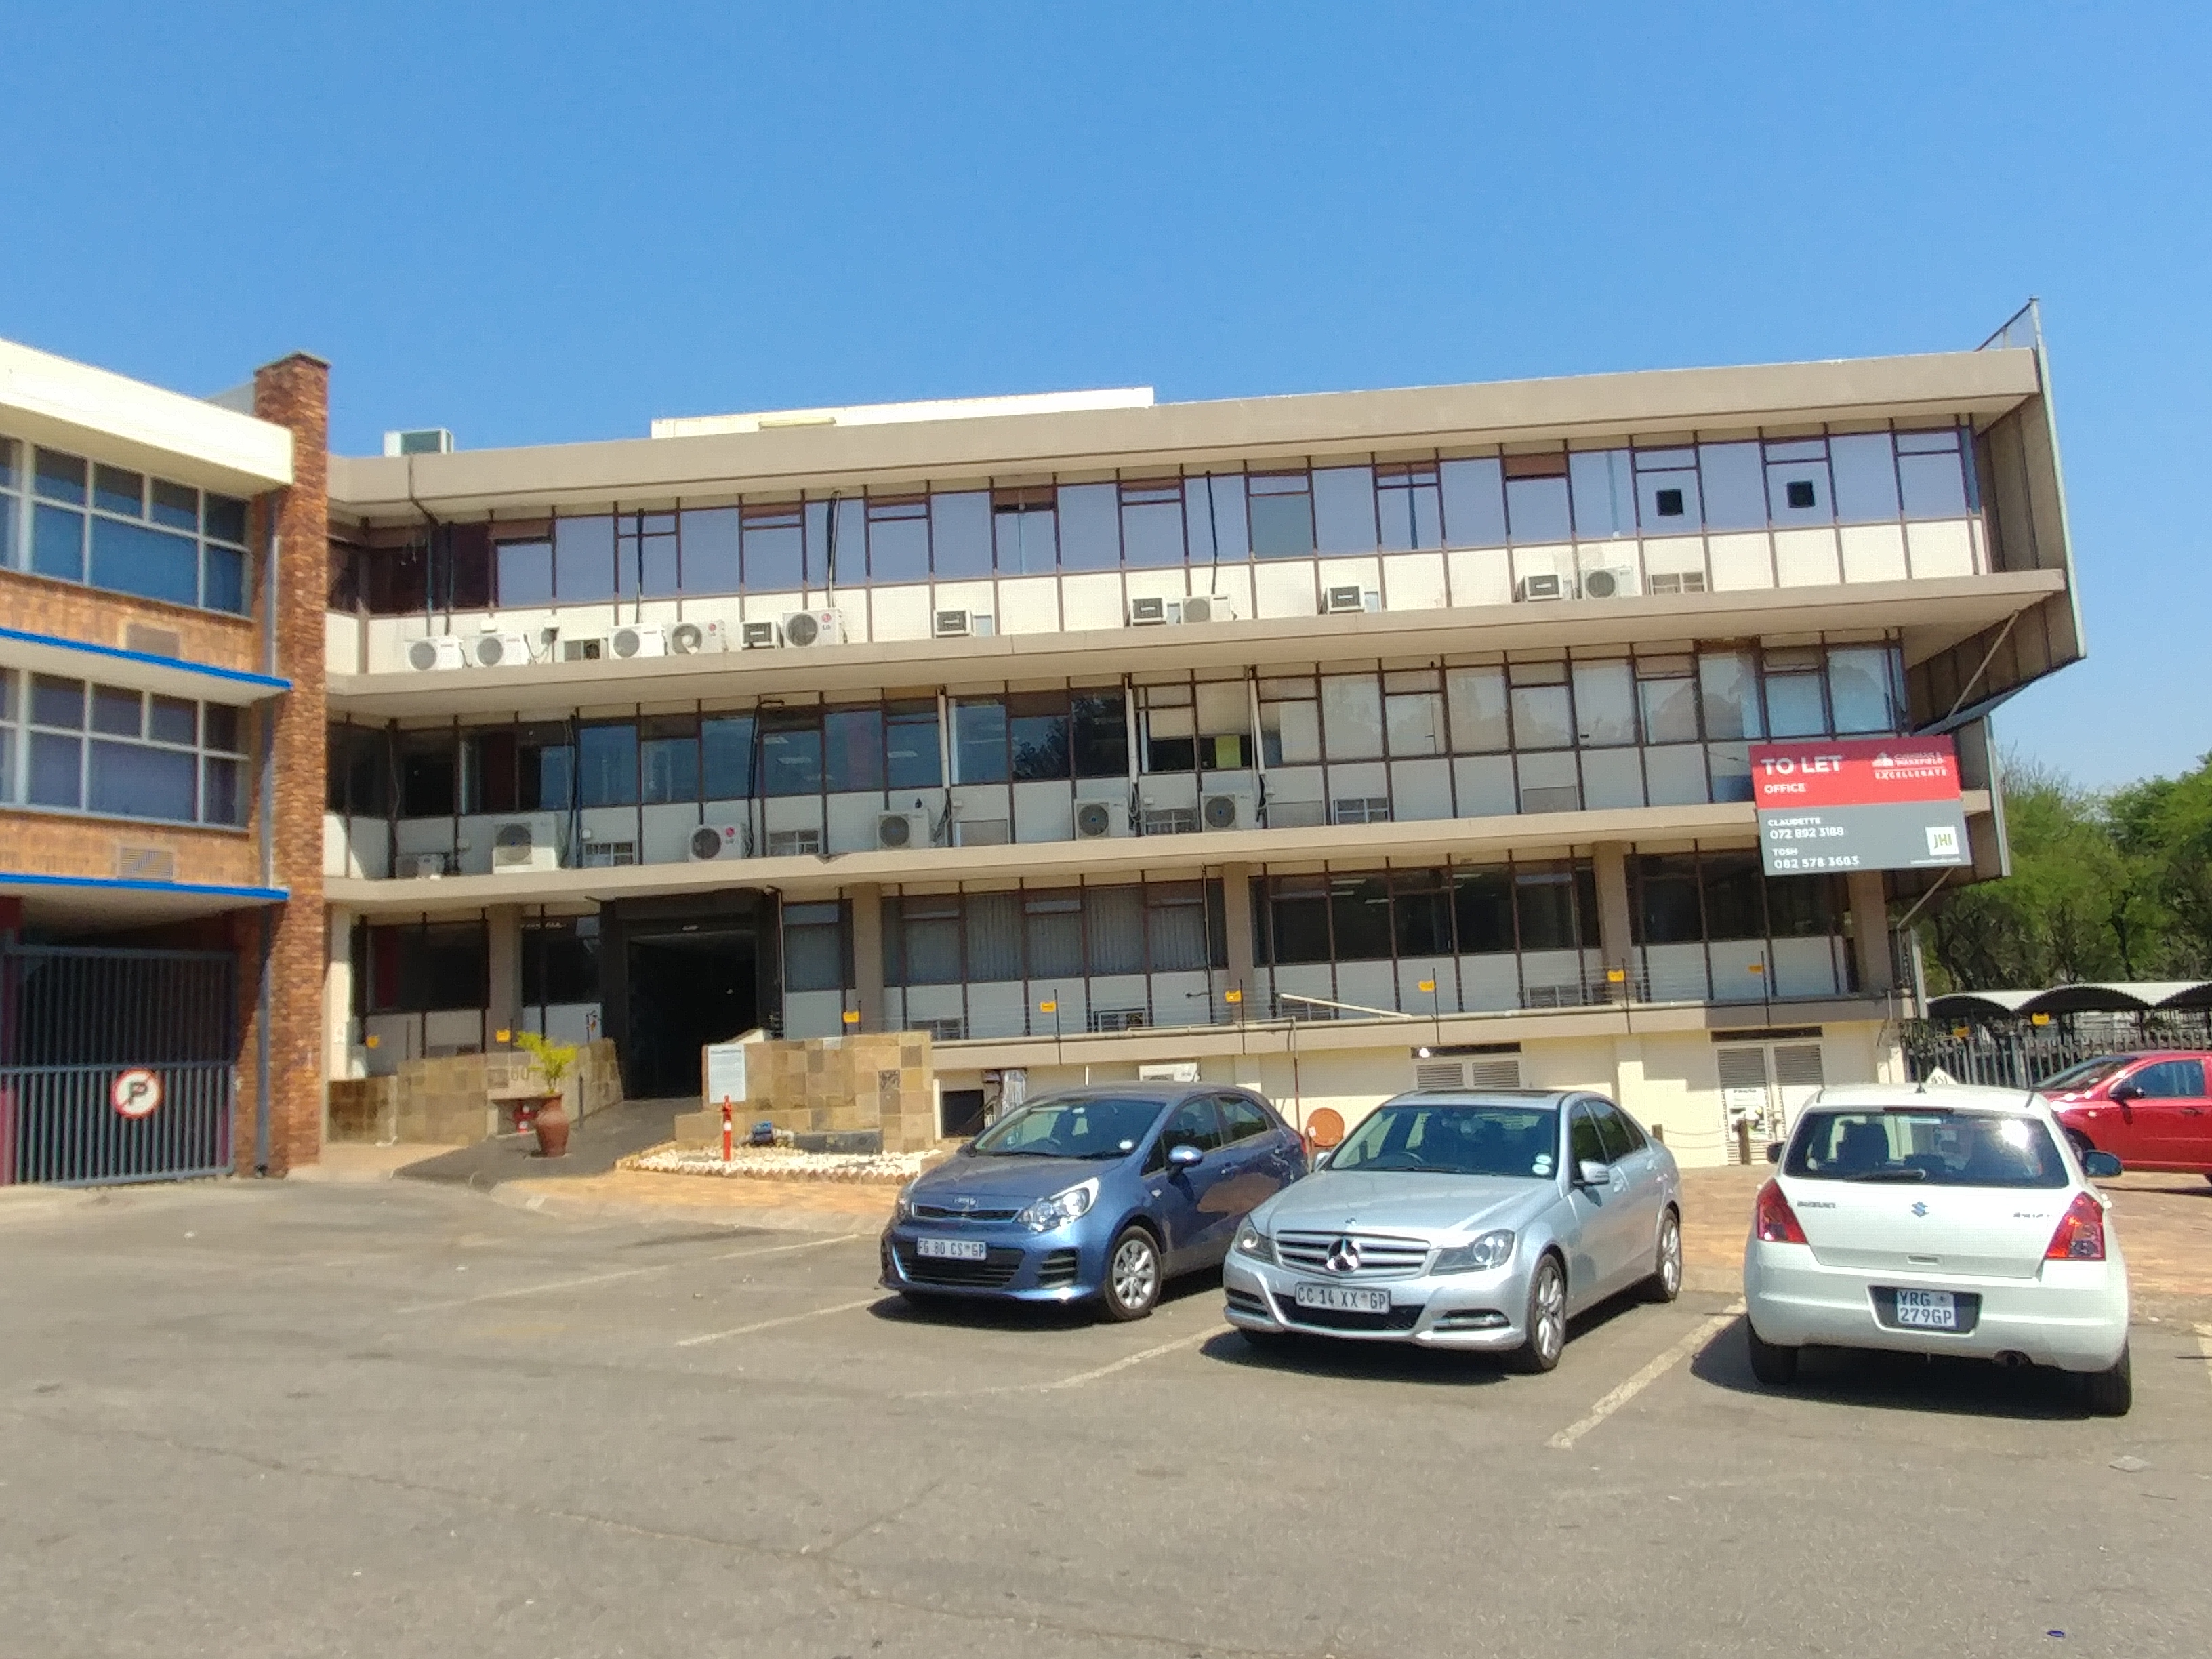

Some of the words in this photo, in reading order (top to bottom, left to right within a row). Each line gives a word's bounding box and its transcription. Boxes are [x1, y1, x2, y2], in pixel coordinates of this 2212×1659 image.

[1760, 758, 1794, 775] TO
[1801, 755, 1843, 773] LET
[1763, 783, 1806, 794] OFFICE
[1769, 829, 1793, 840] 072
[1933, 833, 1953, 849] JHI
[971, 1244, 983, 1258] GP
[1298, 1287, 1313, 1303] CC
[1320, 1288, 1334, 1305] 14
[1341, 1291, 1358, 1308] XX
[1370, 1292, 1385, 1309] GP
[1899, 1290, 1931, 1307] YRG
[1900, 1307, 1952, 1324] 279GP
